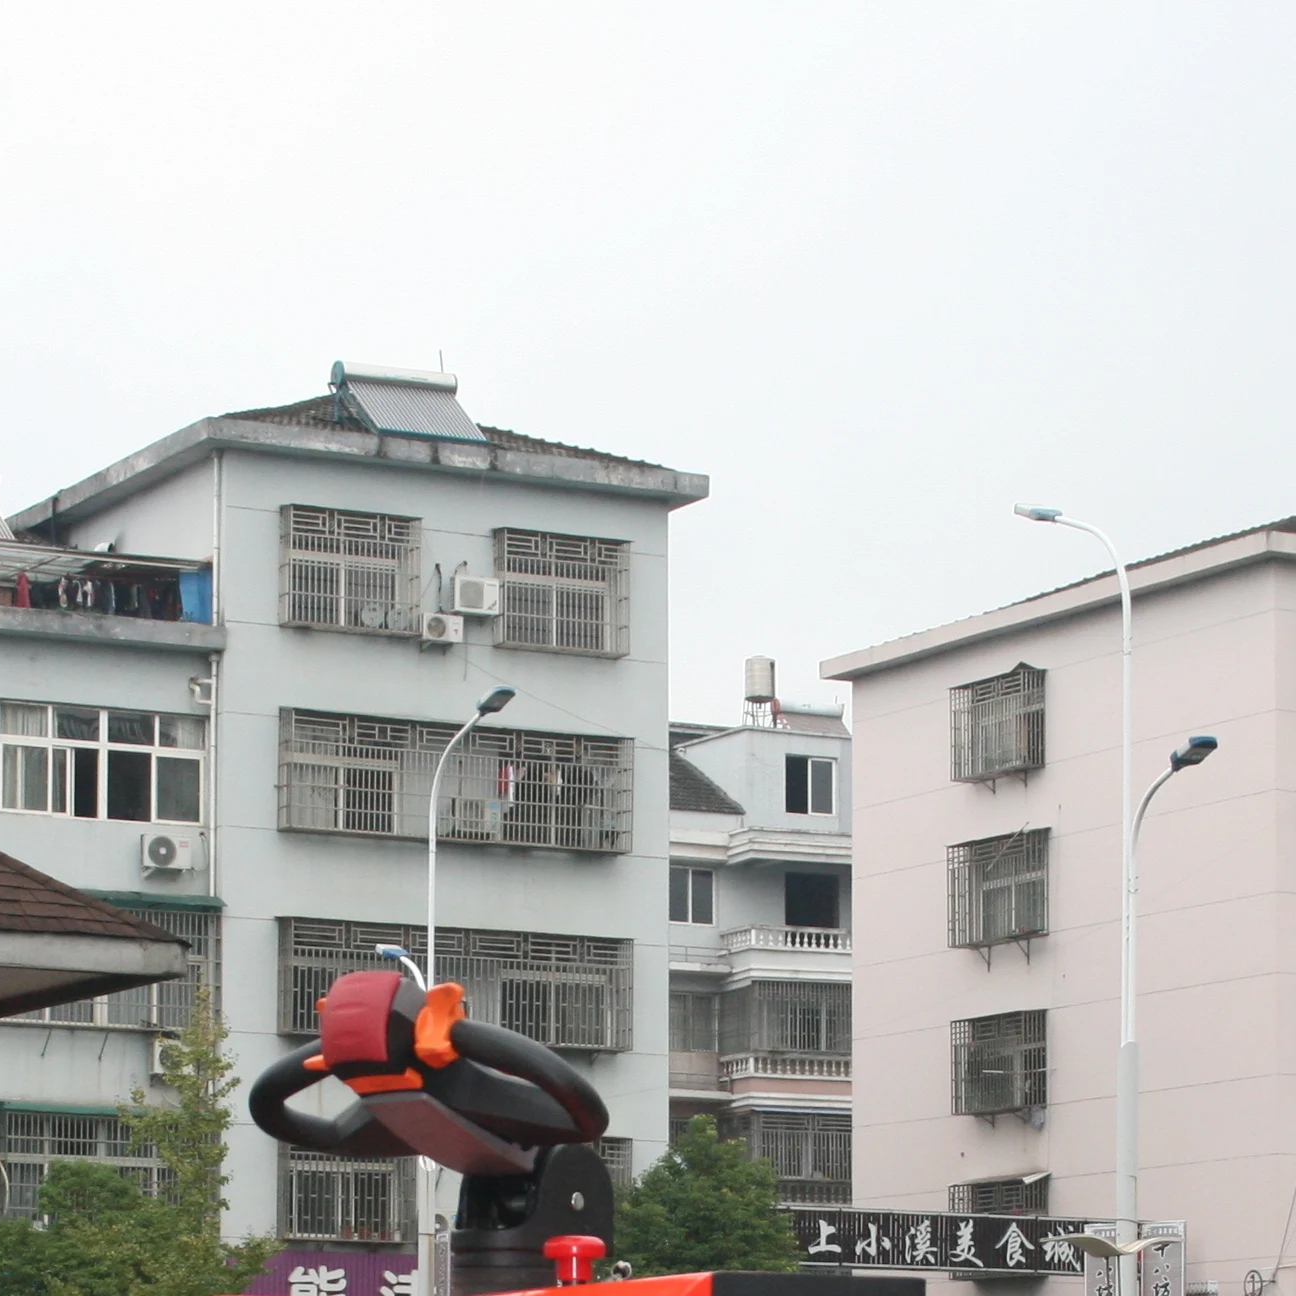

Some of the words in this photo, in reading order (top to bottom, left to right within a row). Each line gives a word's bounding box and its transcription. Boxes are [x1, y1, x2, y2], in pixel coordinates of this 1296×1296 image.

[808, 1219, 1081, 1272] 上小溪美食城
